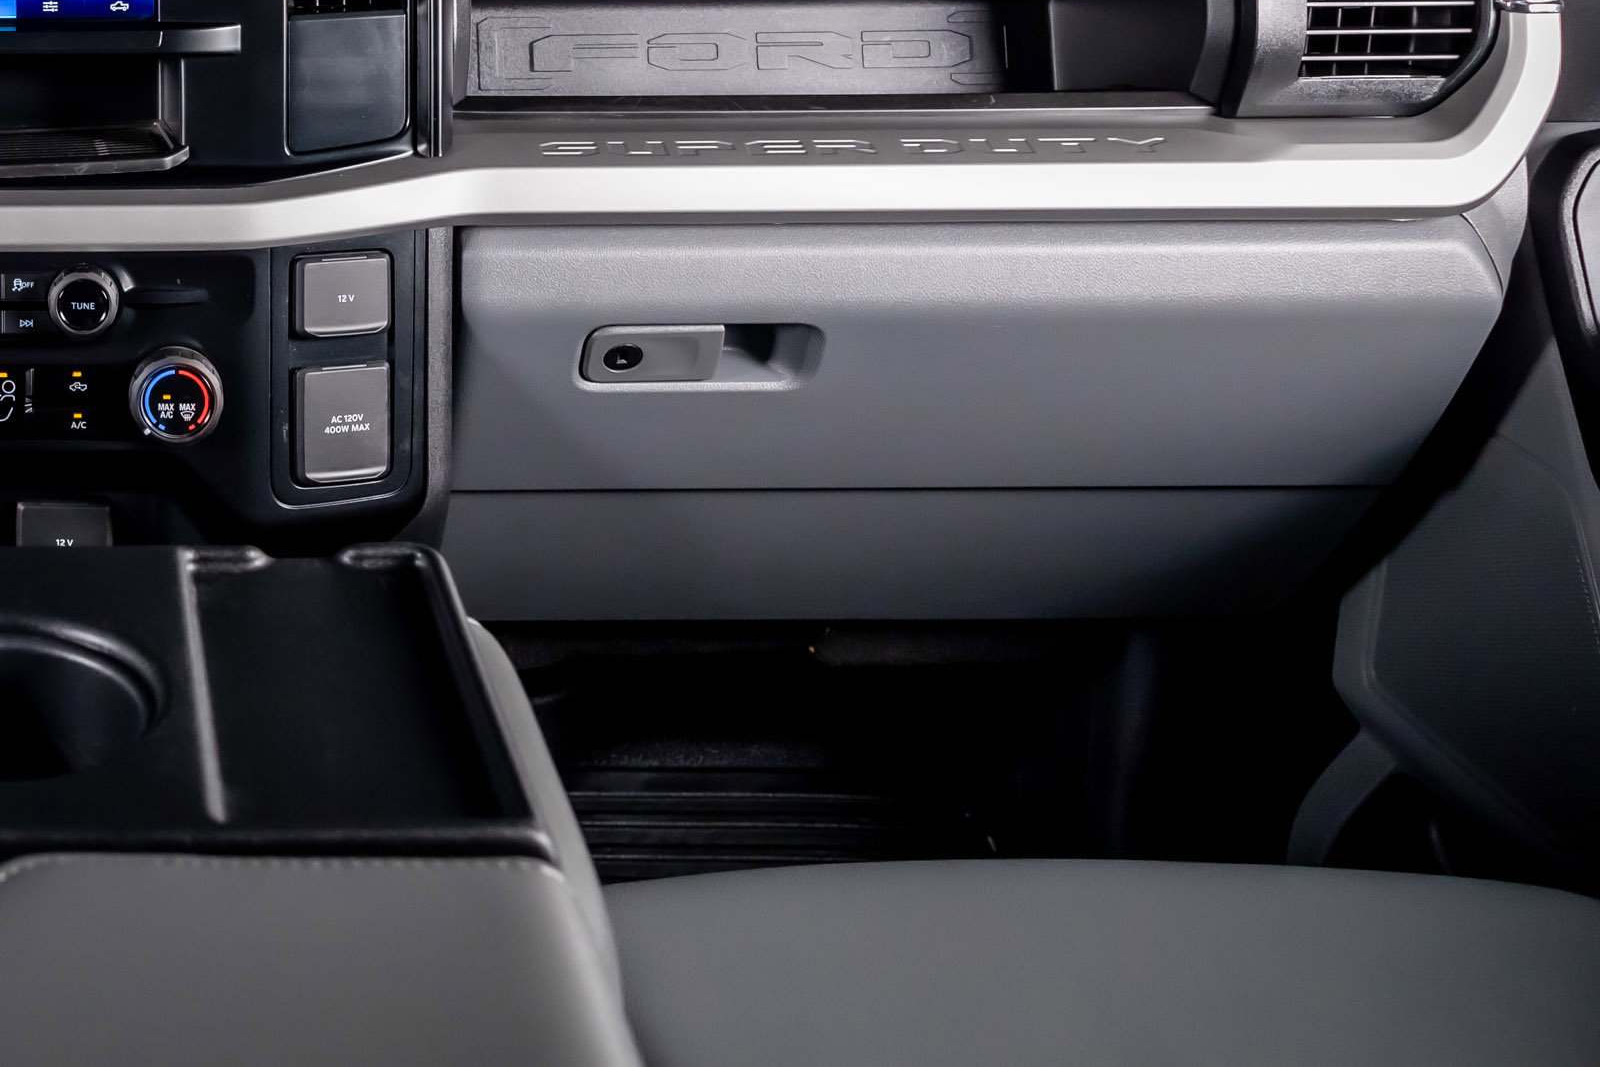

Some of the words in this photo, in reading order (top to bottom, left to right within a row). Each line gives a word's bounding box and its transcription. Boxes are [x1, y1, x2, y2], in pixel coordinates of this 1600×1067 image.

[528, 29, 973, 72] FORD
[539, 138, 877, 156] SUPER
[900, 137, 1166, 155] DUTY
[22, 281, 35, 289] OFF
[337, 294, 347, 303] 12
[348, 294, 355, 302] V
[71, 302, 96, 310] TUNE
[157, 403, 175, 411] MAX
[178, 403, 196, 411] MAX
[160, 411, 174, 419] A/C
[330, 415, 343, 424] AC
[343, 413, 364, 423] 120V
[70, 421, 87, 429] A/C
[324, 424, 350, 434] 400W
[351, 423, 370, 432] MAX
[55, 538, 66, 547] 12
[66, 538, 74, 547] V
